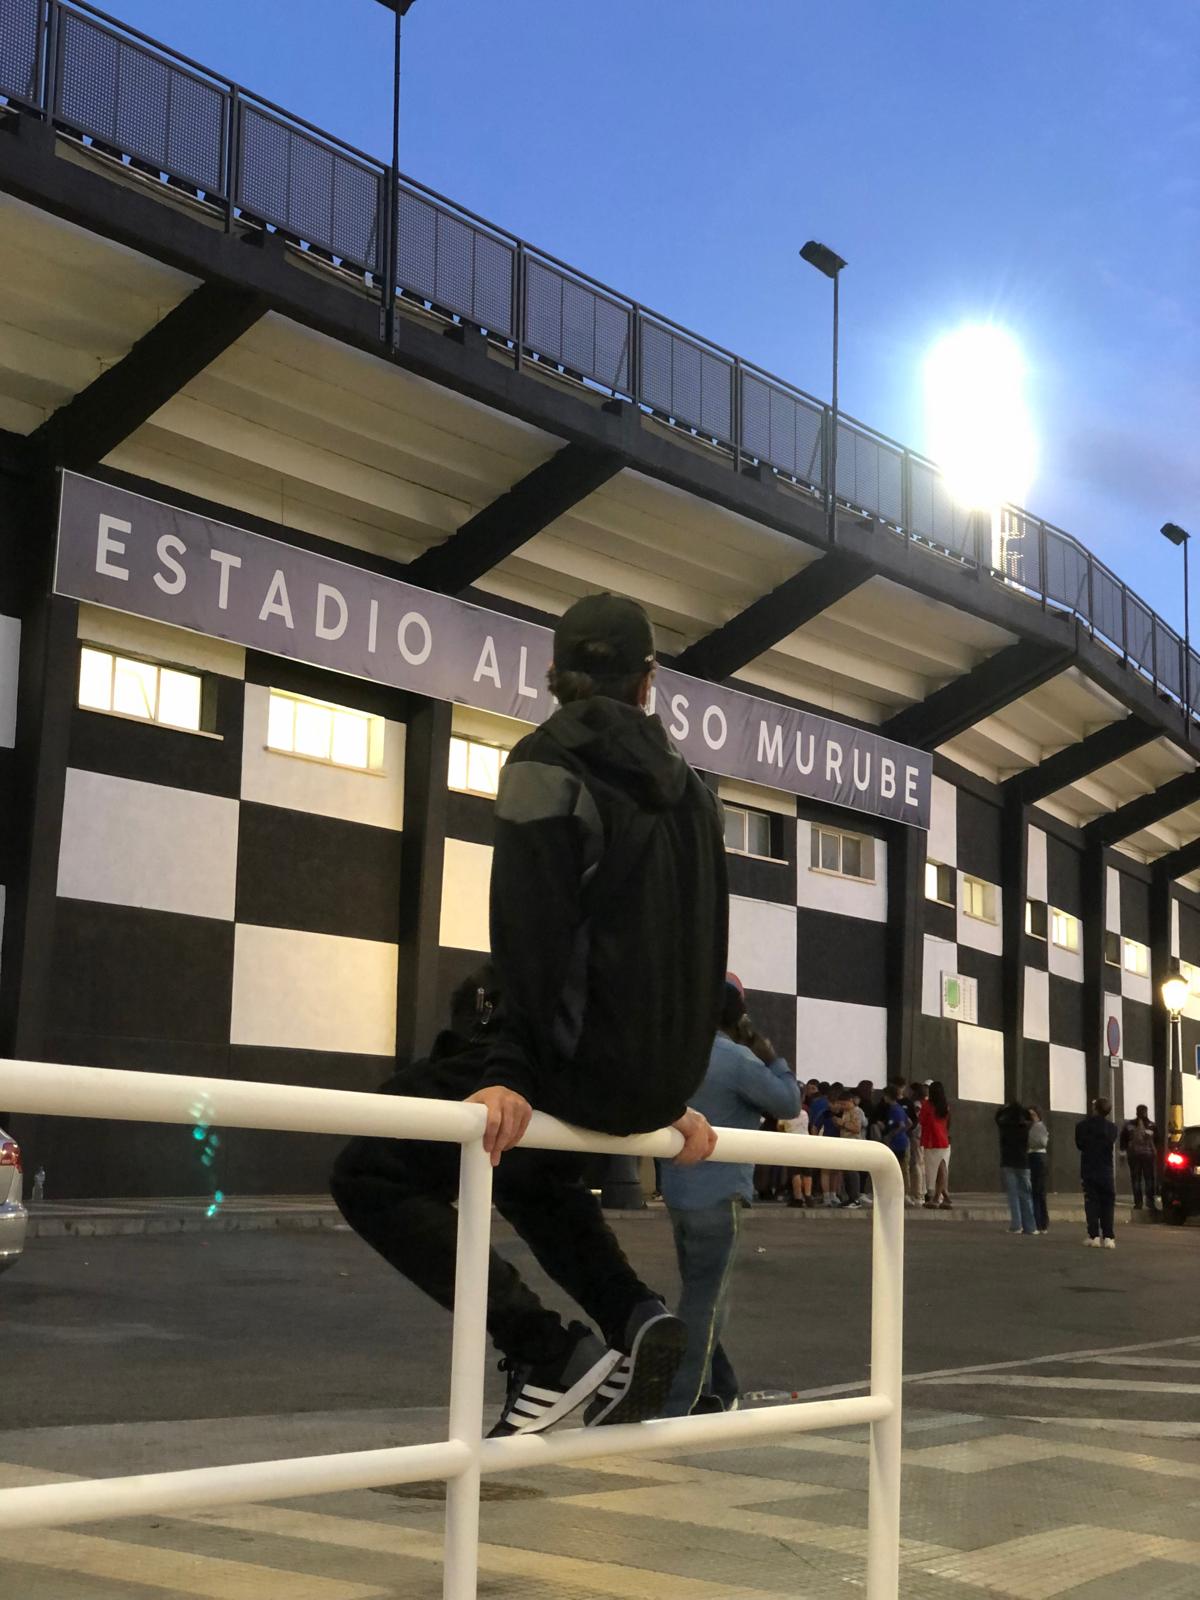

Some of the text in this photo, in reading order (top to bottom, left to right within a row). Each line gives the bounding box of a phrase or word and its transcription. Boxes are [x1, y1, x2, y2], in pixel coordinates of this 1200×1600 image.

[96, 513, 919, 807] ESTADIO ALSO MURUBE
